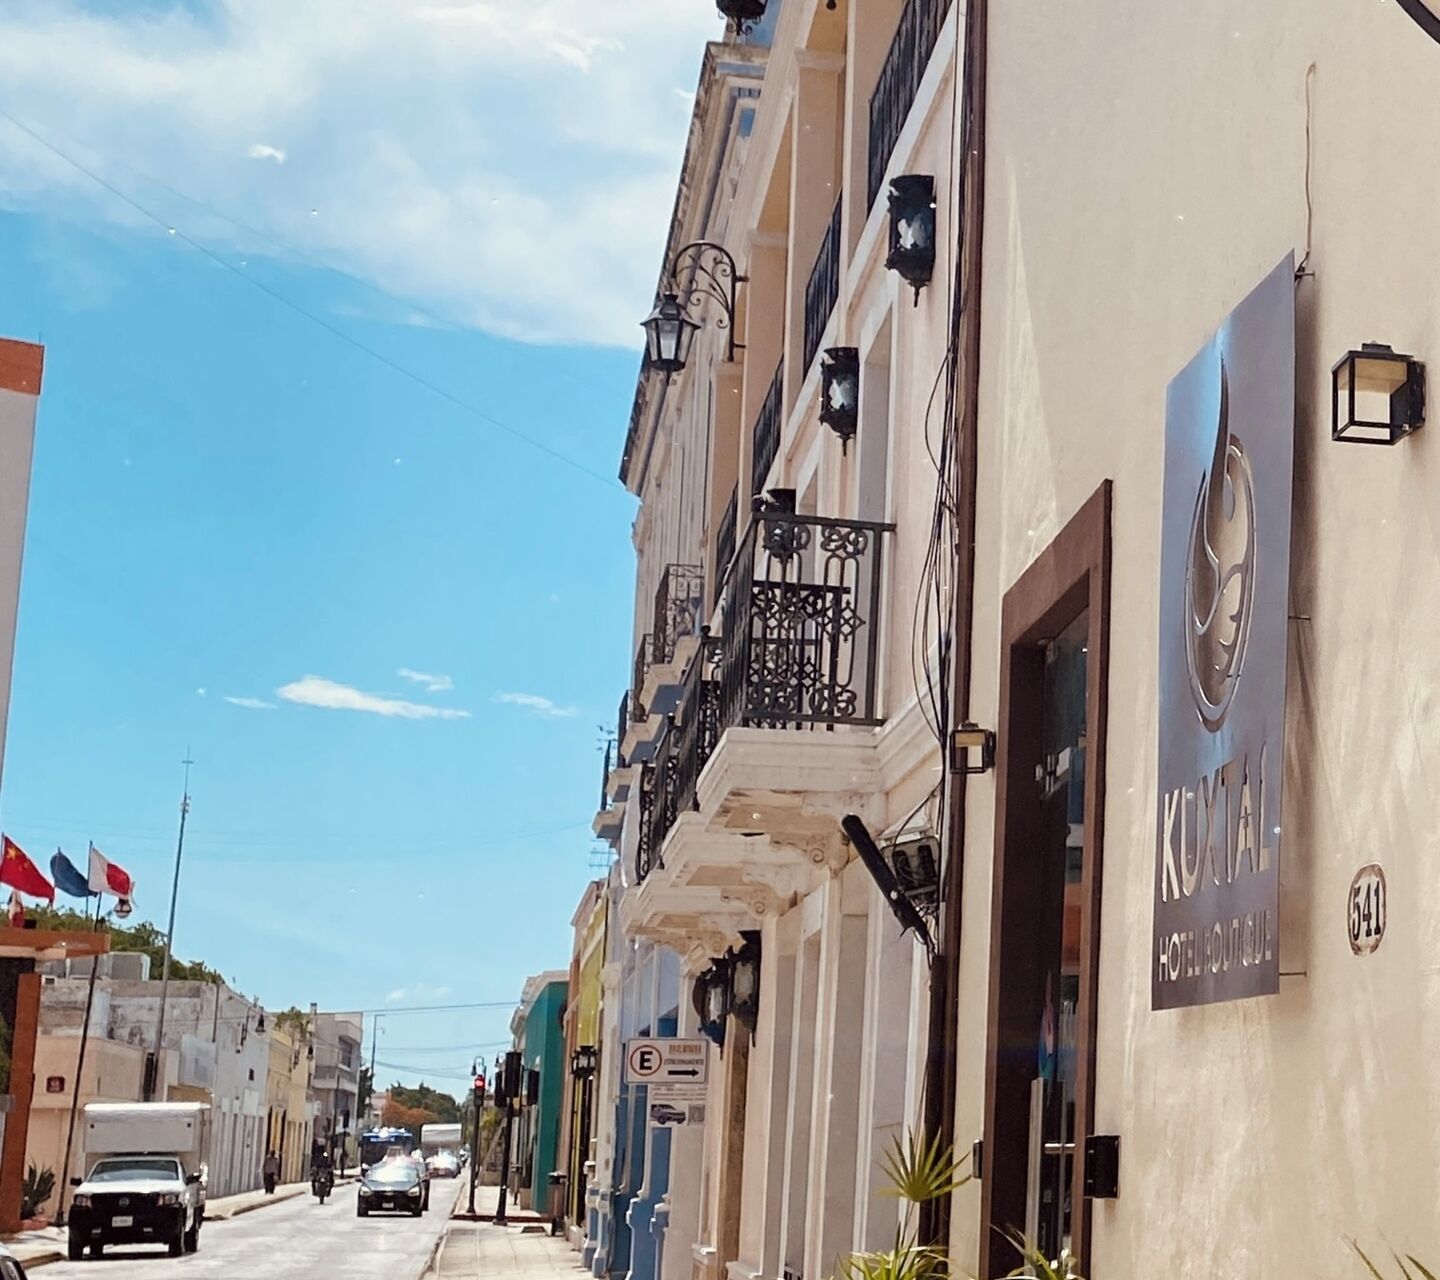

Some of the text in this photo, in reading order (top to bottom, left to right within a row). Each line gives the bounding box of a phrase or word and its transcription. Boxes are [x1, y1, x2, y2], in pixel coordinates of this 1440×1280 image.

[1161, 741, 1272, 903] KUXTAL
[1351, 880, 1383, 942] 541
[1158, 931, 1200, 982] HOTEL
[639, 1050, 653, 1070] E
